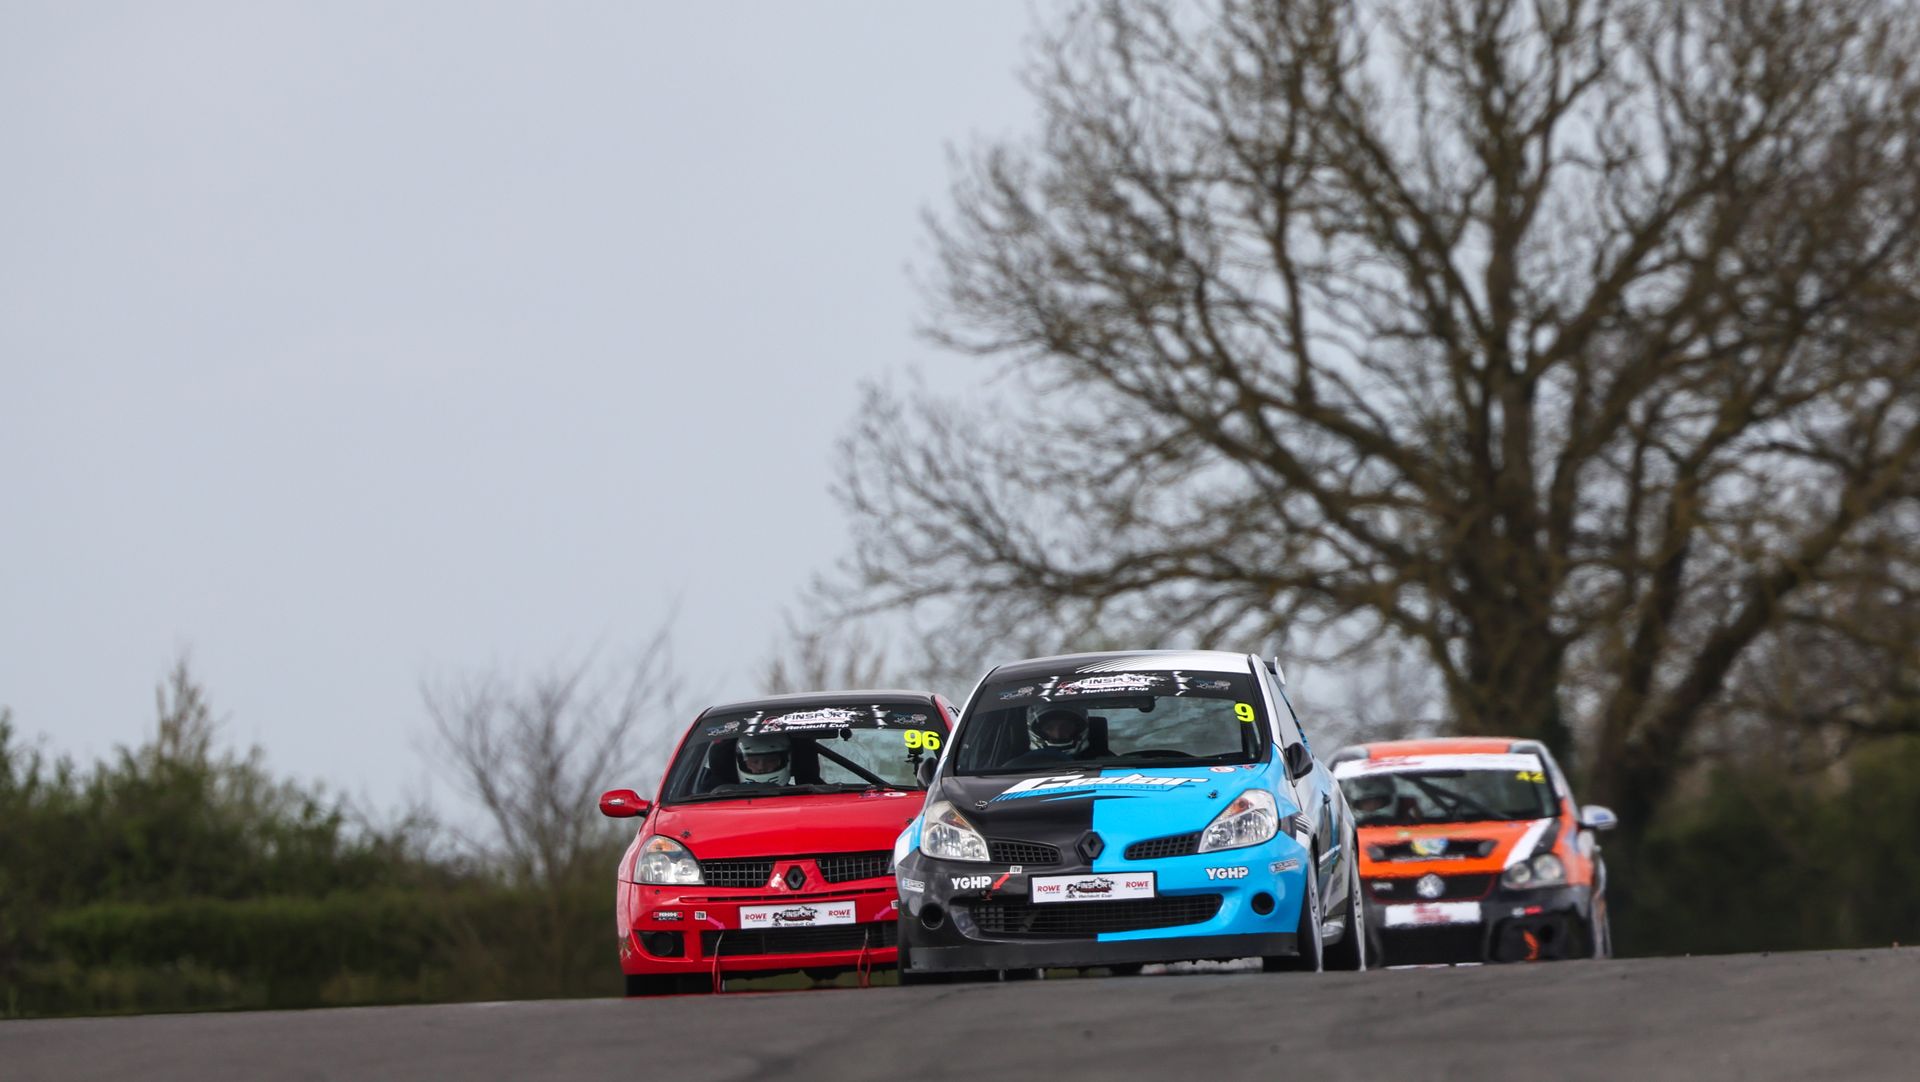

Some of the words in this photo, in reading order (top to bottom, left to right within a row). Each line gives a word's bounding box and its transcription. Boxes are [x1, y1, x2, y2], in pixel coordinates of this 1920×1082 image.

[1080, 676, 1150, 686] FINSPORT
[783, 709, 850, 721] FINSPORT
[1234, 702, 1255, 723] 9
[785, 723, 827, 731] Renault
[903, 729, 941, 751] 96
[1514, 770, 1547, 784] 42
[1036, 783, 1167, 794] MOTORSPORT
[1205, 865, 1249, 880] YGHP
[951, 876, 992, 890] YGHP
[1037, 884, 1061, 892] ROWE
[1076, 880, 1113, 889] FINSPORT
[1125, 880, 1149, 888] ROWE
[782, 908, 817, 919] FINSPORT
